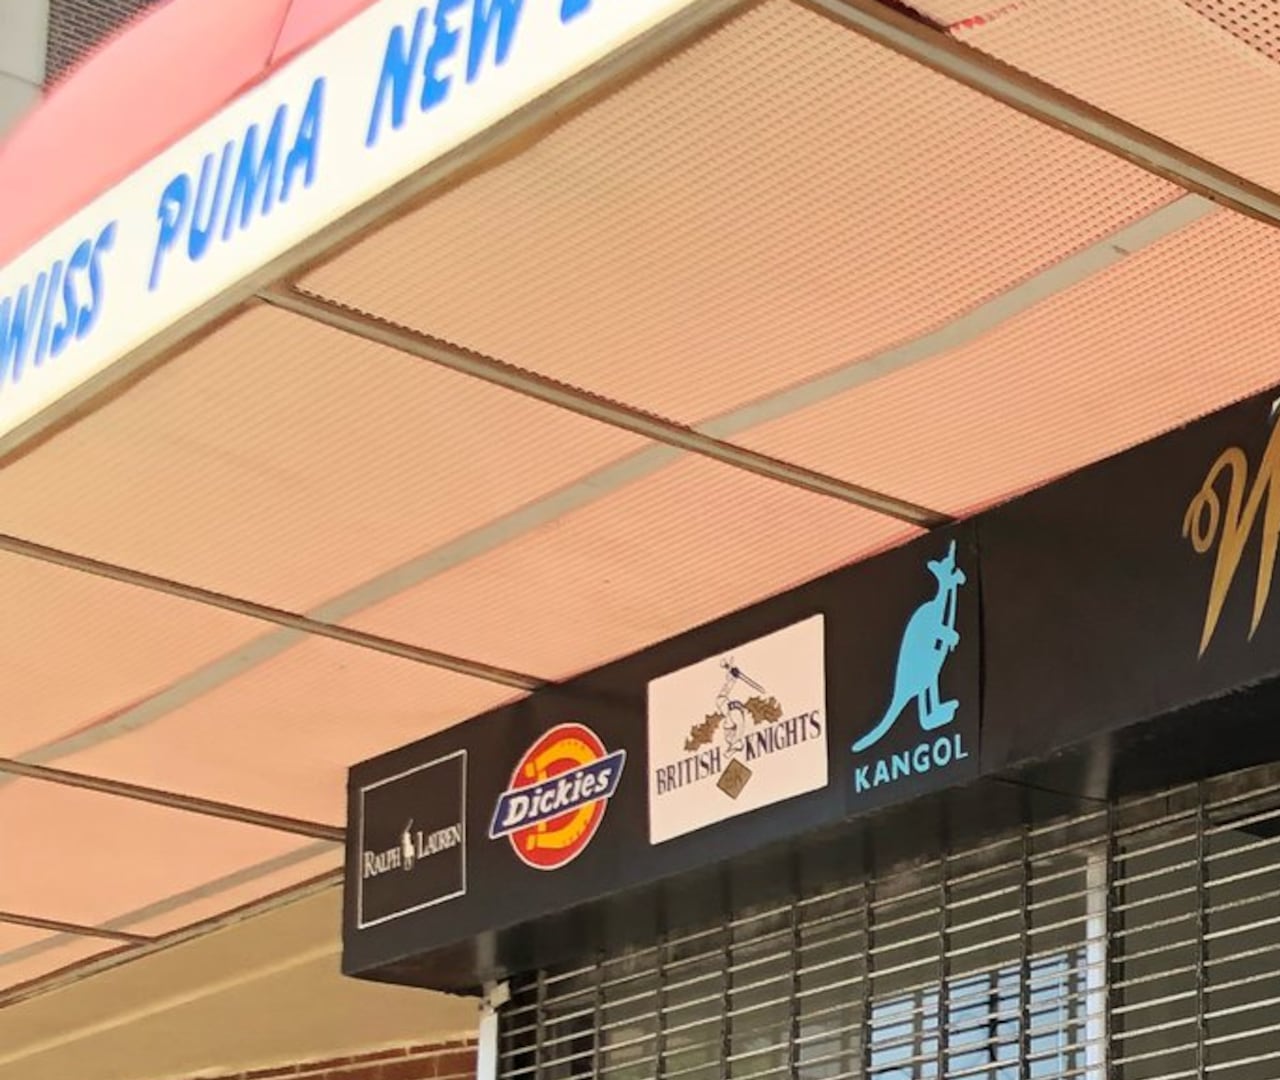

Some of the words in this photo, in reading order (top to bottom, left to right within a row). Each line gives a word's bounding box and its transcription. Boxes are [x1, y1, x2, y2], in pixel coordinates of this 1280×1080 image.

[148, 76, 326, 292] PUMA
[365, 0, 525, 148] NEW
[656, 746, 722, 795] BRITISH
[744, 709, 823, 763] KNIGHTS
[855, 733, 969, 794] KANGOL
[502, 767, 612, 827] Dickies
